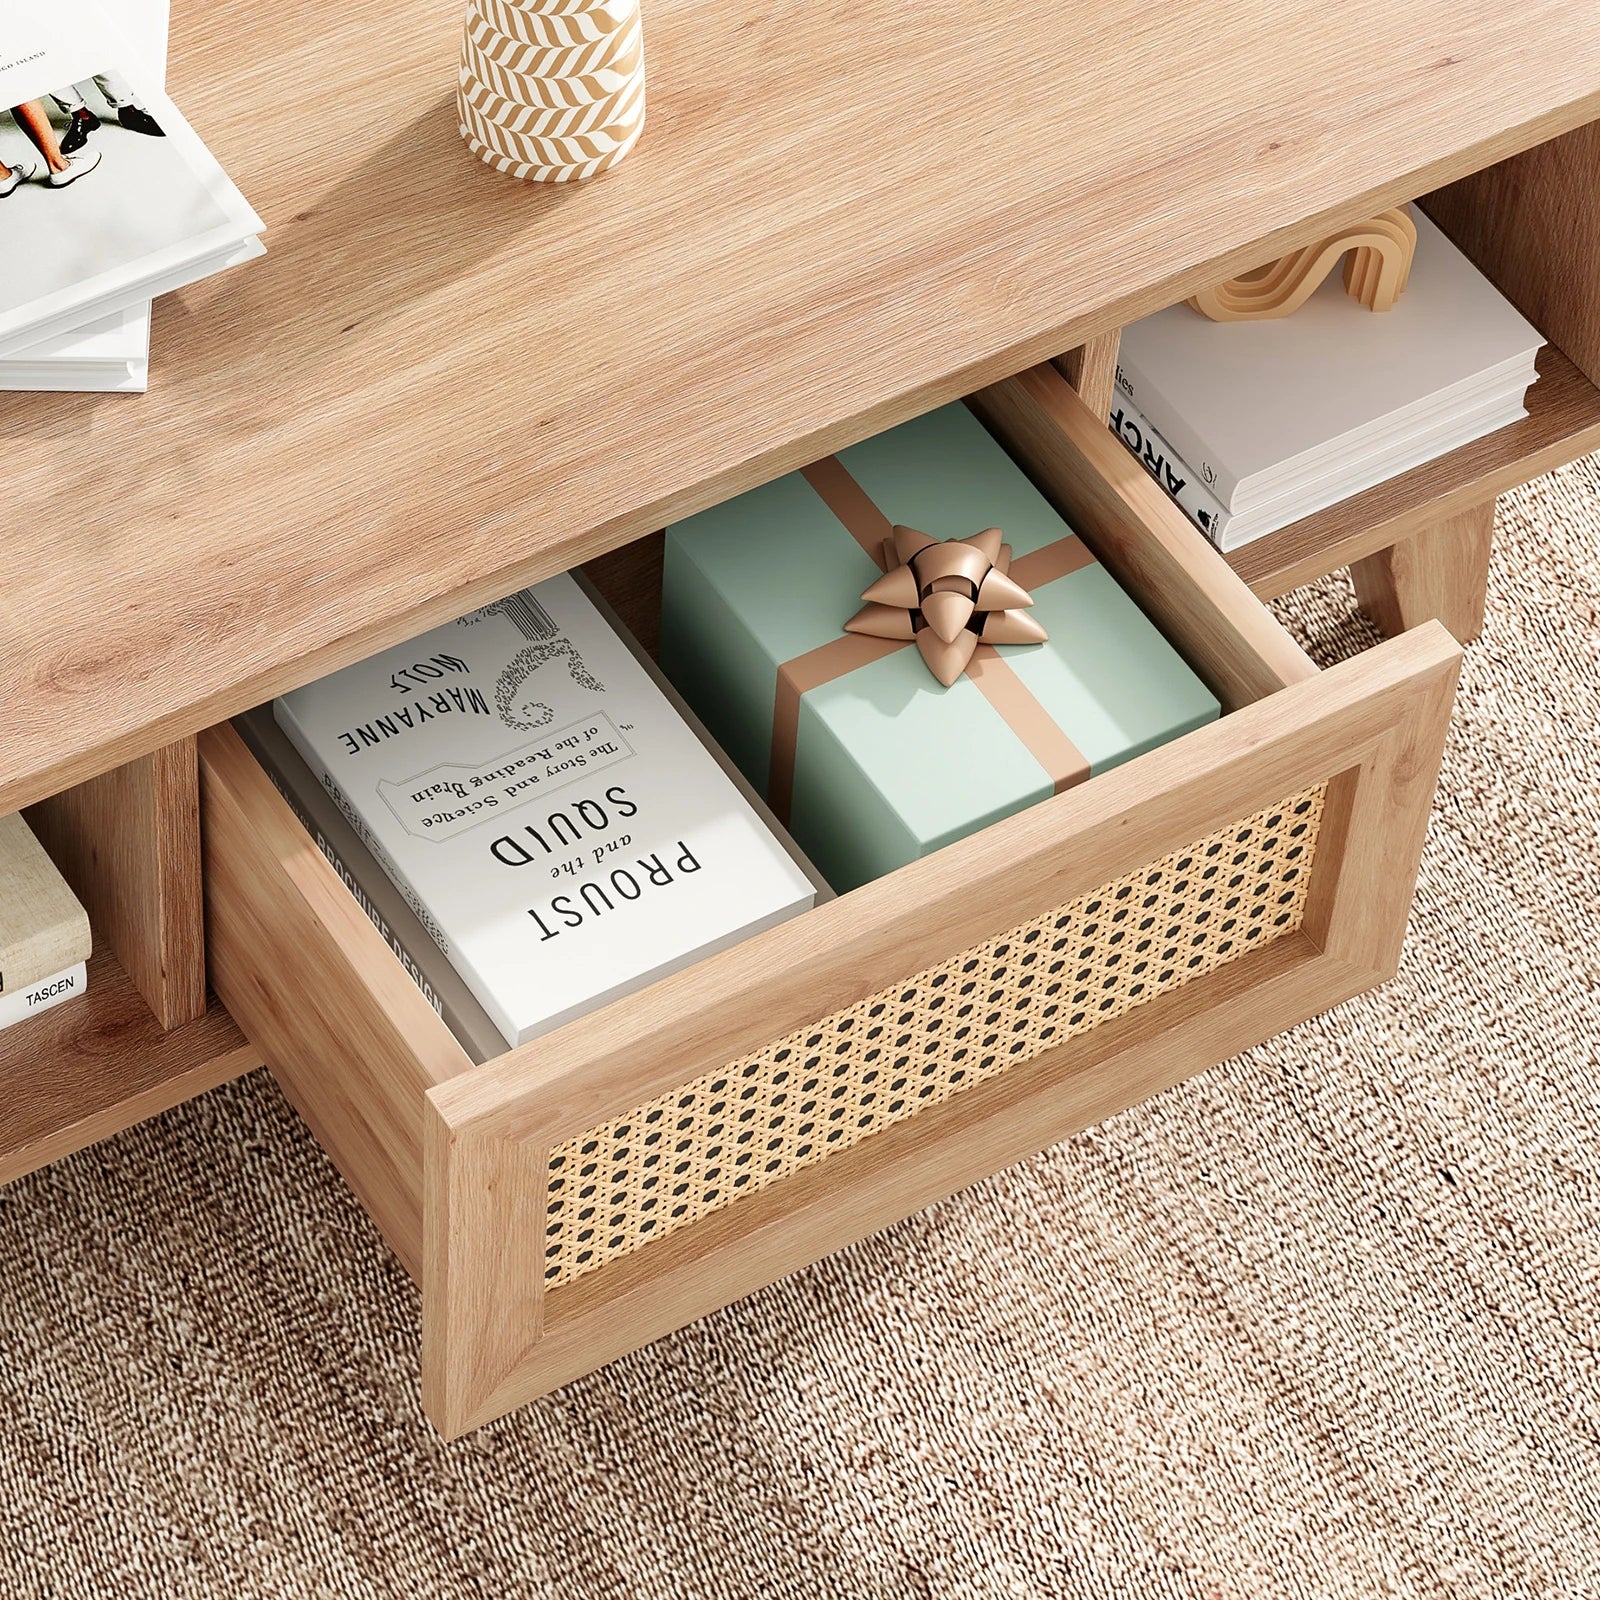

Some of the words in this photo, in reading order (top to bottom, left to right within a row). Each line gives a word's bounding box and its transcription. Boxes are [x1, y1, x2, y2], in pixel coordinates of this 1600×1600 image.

[15, 51, 46, 66] ISLAND
[390, 653, 470, 694] WOLF
[337, 687, 491, 755] MARYANNE
[582, 726, 599, 742] of
[554, 735, 580, 751] the
[590, 741, 619, 758] The
[469, 748, 554, 788] Reading
[546, 754, 587, 778] Story
[410, 781, 470, 803] Brain
[504, 775, 540, 798] and
[421, 795, 499, 828] Science
[489, 786, 638, 867] SQUID
[592, 834, 632, 863] and
[550, 857, 585, 878] the
[527, 840, 702, 942] PROUST
[25, 976, 75, 1007] TASCEN
